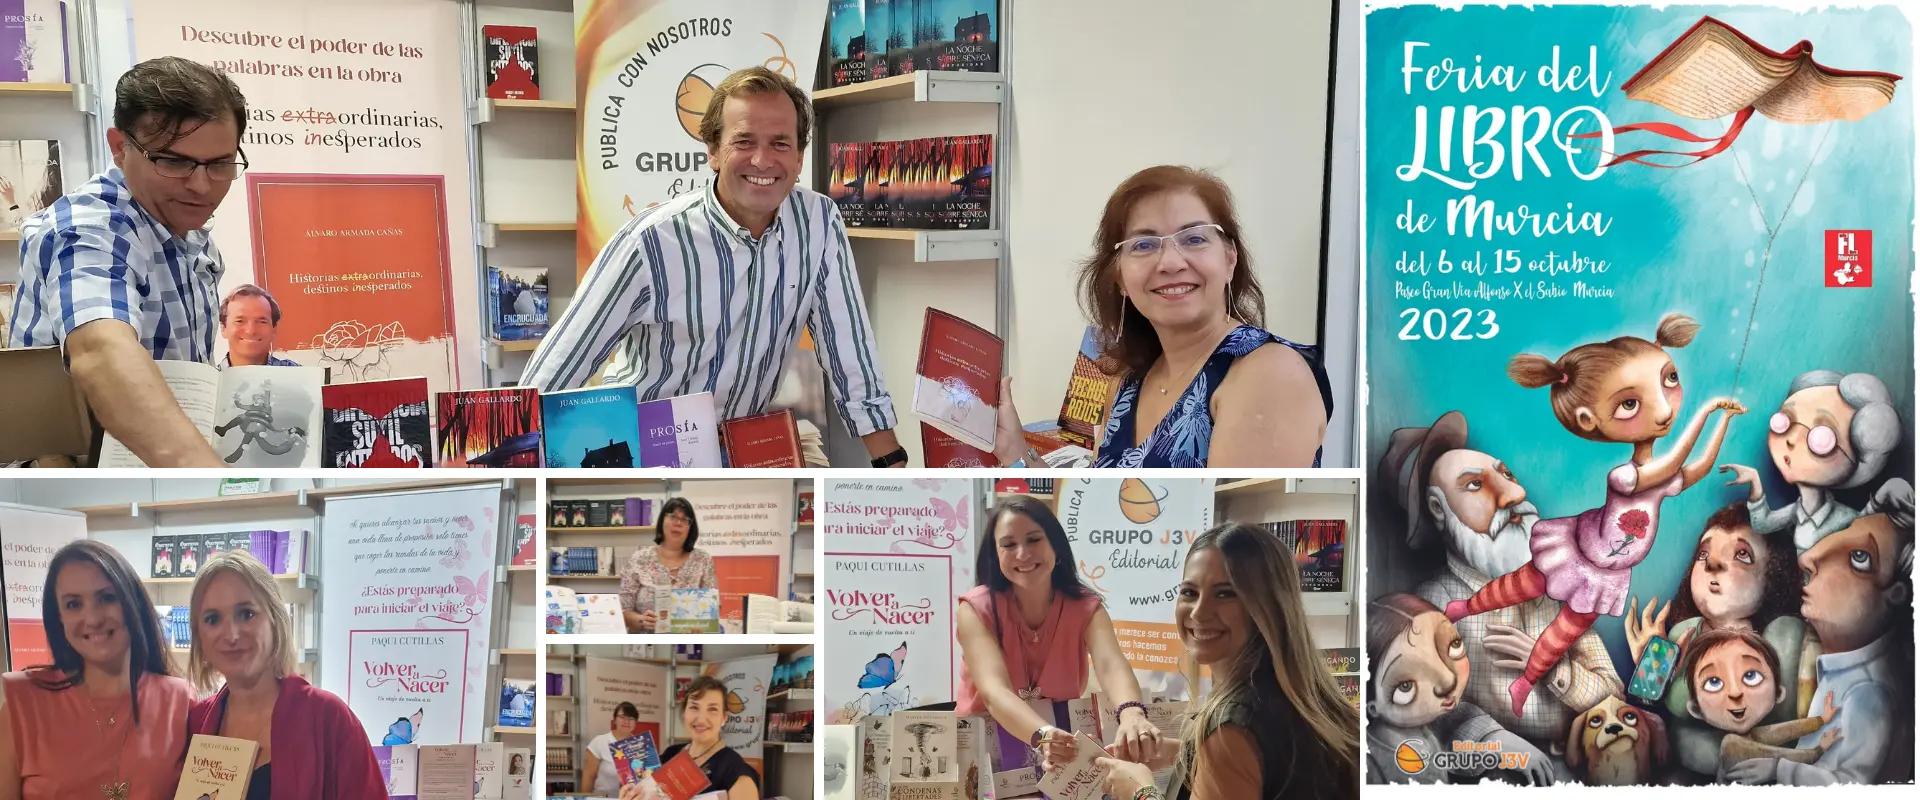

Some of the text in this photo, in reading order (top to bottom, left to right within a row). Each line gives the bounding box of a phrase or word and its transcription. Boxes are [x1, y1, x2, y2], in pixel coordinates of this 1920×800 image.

[4, 14, 44, 23] PROSÍA
[181, 25, 424, 59] Descubre el poder de las
[945, 46, 955, 54] LA
[962, 53, 991, 62] SÉNECA
[308, 65, 332, 79] en
[338, 65, 353, 80] la
[358, 67, 402, 83] obra
[1401, 41, 1612, 98] Feria del
[600, 17, 733, 170] PUBLICA CON NOSOTROS
[280, 106, 444, 130] extraordinarias,
[304, 128, 422, 153] inesperados
[1395, 105, 1615, 191] LIBRO
[956, 202, 981, 210] NOCHE
[962, 210, 988, 218] SÉNECA
[1396, 194, 1613, 241] de Murcia
[306, 227, 403, 238] ÁLVARO ARMADA CAÑAS
[1395, 248, 1611, 277] del 6 al 15 octubre
[289, 272, 340, 284] Historias
[303, 280, 412, 294] destinos inesperados
[1395, 280, 1421, 300] Paseo
[1422, 280, 1452, 300] Gran
[1473, 280, 1513, 302] Alfonso
[1513, 280, 1523, 300] X
[1524, 282, 1535, 300] el
[1536, 280, 1567, 300] Sabio
[1573, 282, 1615, 299] Murcia
[504, 314, 548, 324] ENCRUCIJADA
[1397, 307, 1500, 341] 2023
[454, 395, 522, 406] JUAN GALLARDO
[560, 394, 620, 408] JUAN GALLARDO
[1066, 398, 1102, 425] ROJOS
[650, 420, 698, 439] PROSÍA
[834, 482, 864, 492] ponerte
[875, 483, 904, 492] camino
[694, 502, 727, 511] Descubre
[734, 502, 756, 511] poder
[758, 502, 766, 510] de
[864, 504, 937, 518] preparado
[1067, 488, 1085, 542] PUBLICA
[359, 516, 450, 532] quieres alcanzar tus sueños y
[846, 522, 945, 538] iniciar el viaje?
[362, 534, 376, 543] vida
[378, 533, 393, 543] llena
[394, 532, 402, 542] de
[436, 530, 449, 540] solo
[450, 532, 468, 540] tienes
[1088, 529, 1197, 545] GRUPO J3V
[15, 544, 44, 554] poder
[354, 553, 366, 563] que
[366, 552, 382, 563] coger
[384, 549, 393, 558] las
[420, 547, 428, 557] de
[438, 546, 454, 556] vida
[453, 548, 460, 560] y
[14, 560, 36, 568] en la
[1108, 548, 1180, 570] Editorial
[375, 566, 398, 576] ponerte
[835, 561, 925, 572] PAQUI CUTILLAS
[1316, 576, 1340, 584] SÉNECA
[361, 584, 459, 598] ¿Estás preparado
[825, 589, 900, 610] Volver a
[354, 601, 466, 616] para iniciar el viaje?
[872, 608, 935, 626] Nacer
[1119, 628, 1146, 637] merece
[1147, 629, 1159, 638] ser
[371, 636, 444, 647] PAQUI CUTILLAS
[1132, 640, 1167, 652] hacemos
[1137, 652, 1143, 660] la
[364, 661, 419, 680] Volver a
[396, 678, 449, 694] Nacer
[1453, 741, 1500, 752] Editorial
[192, 756, 222, 769] Volver
[1434, 753, 1529, 770] GRUPO J3V
[208, 768, 238, 782] Nacer
[1059, 769, 1086, 798] Volver
[898, 787, 942, 796] CONDENAS
